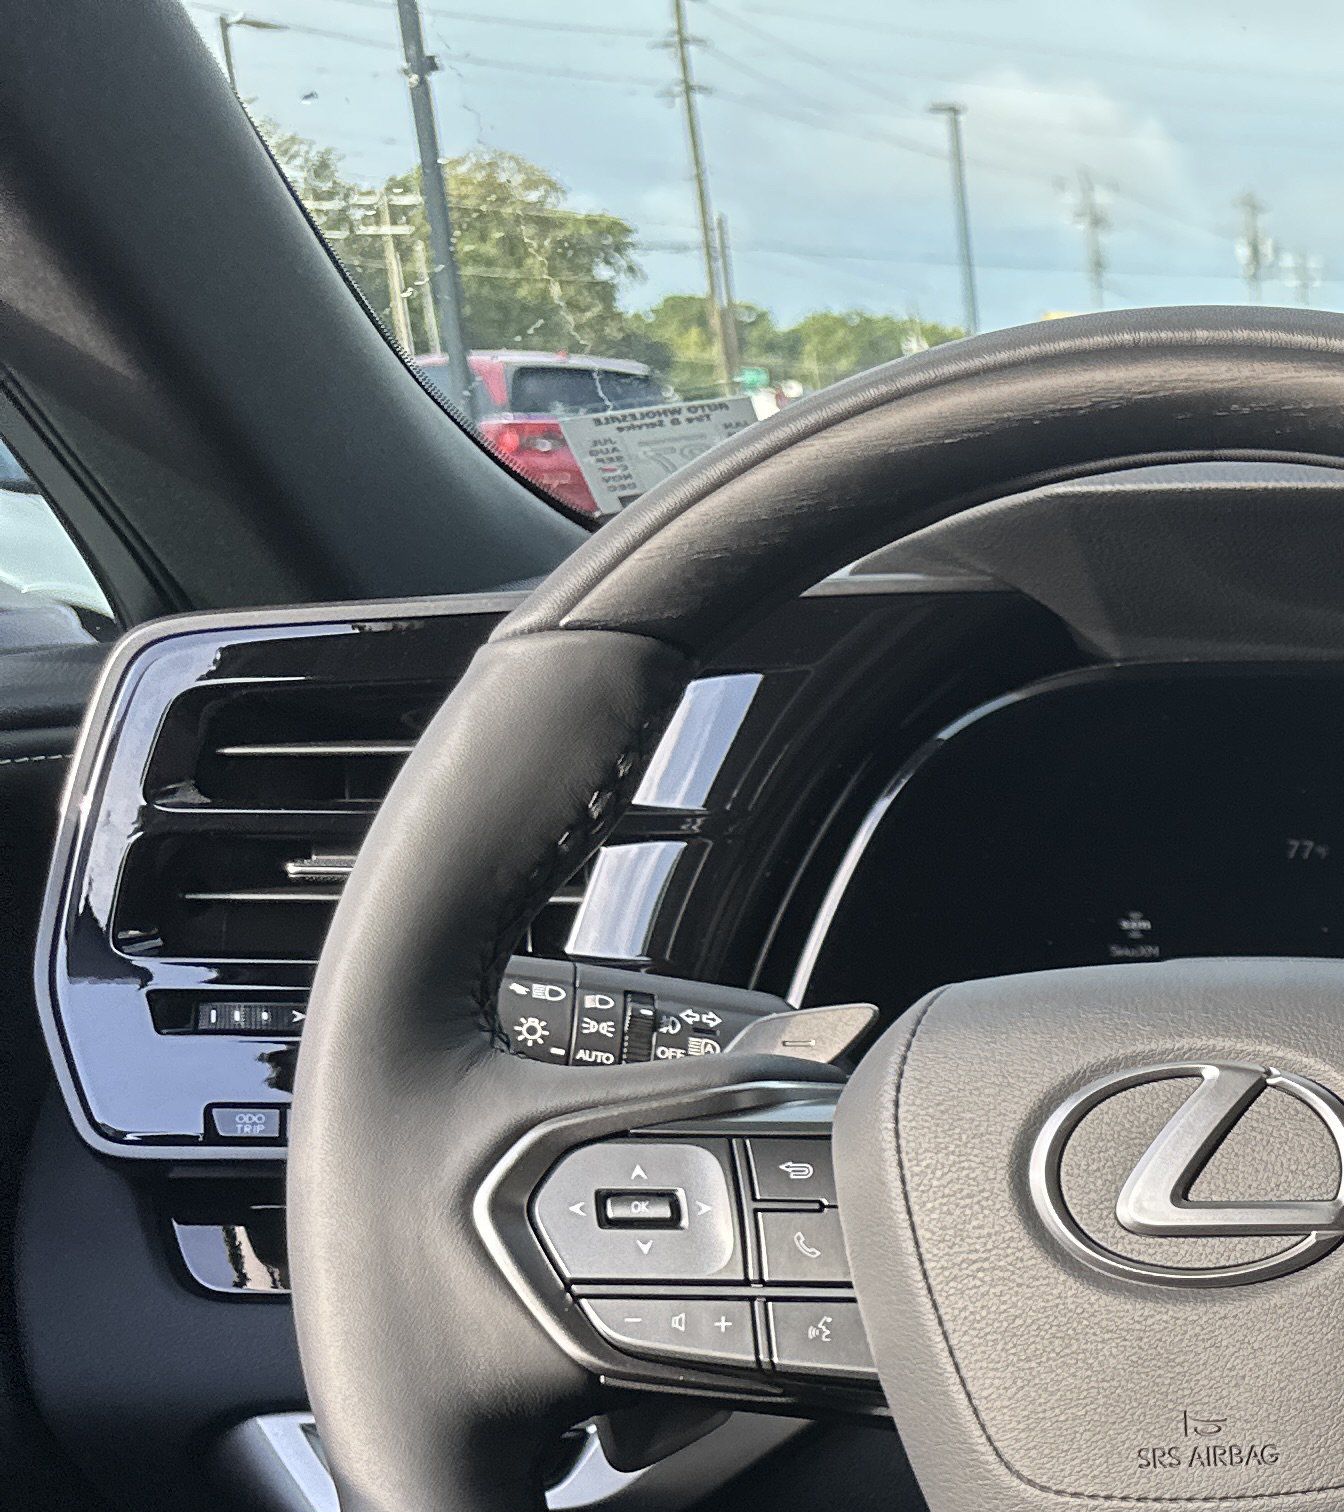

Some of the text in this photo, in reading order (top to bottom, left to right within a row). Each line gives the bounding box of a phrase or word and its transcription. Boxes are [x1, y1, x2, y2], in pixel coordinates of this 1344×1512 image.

[576, 1049, 615, 1065] AUTO
[235, 1113, 265, 1124] ODO
[235, 1124, 265, 1135] TRIP
[631, 1201, 650, 1214] OK
[1137, 1446, 1181, 1469] SRS
[1188, 1443, 1280, 1468] AIRBAG
